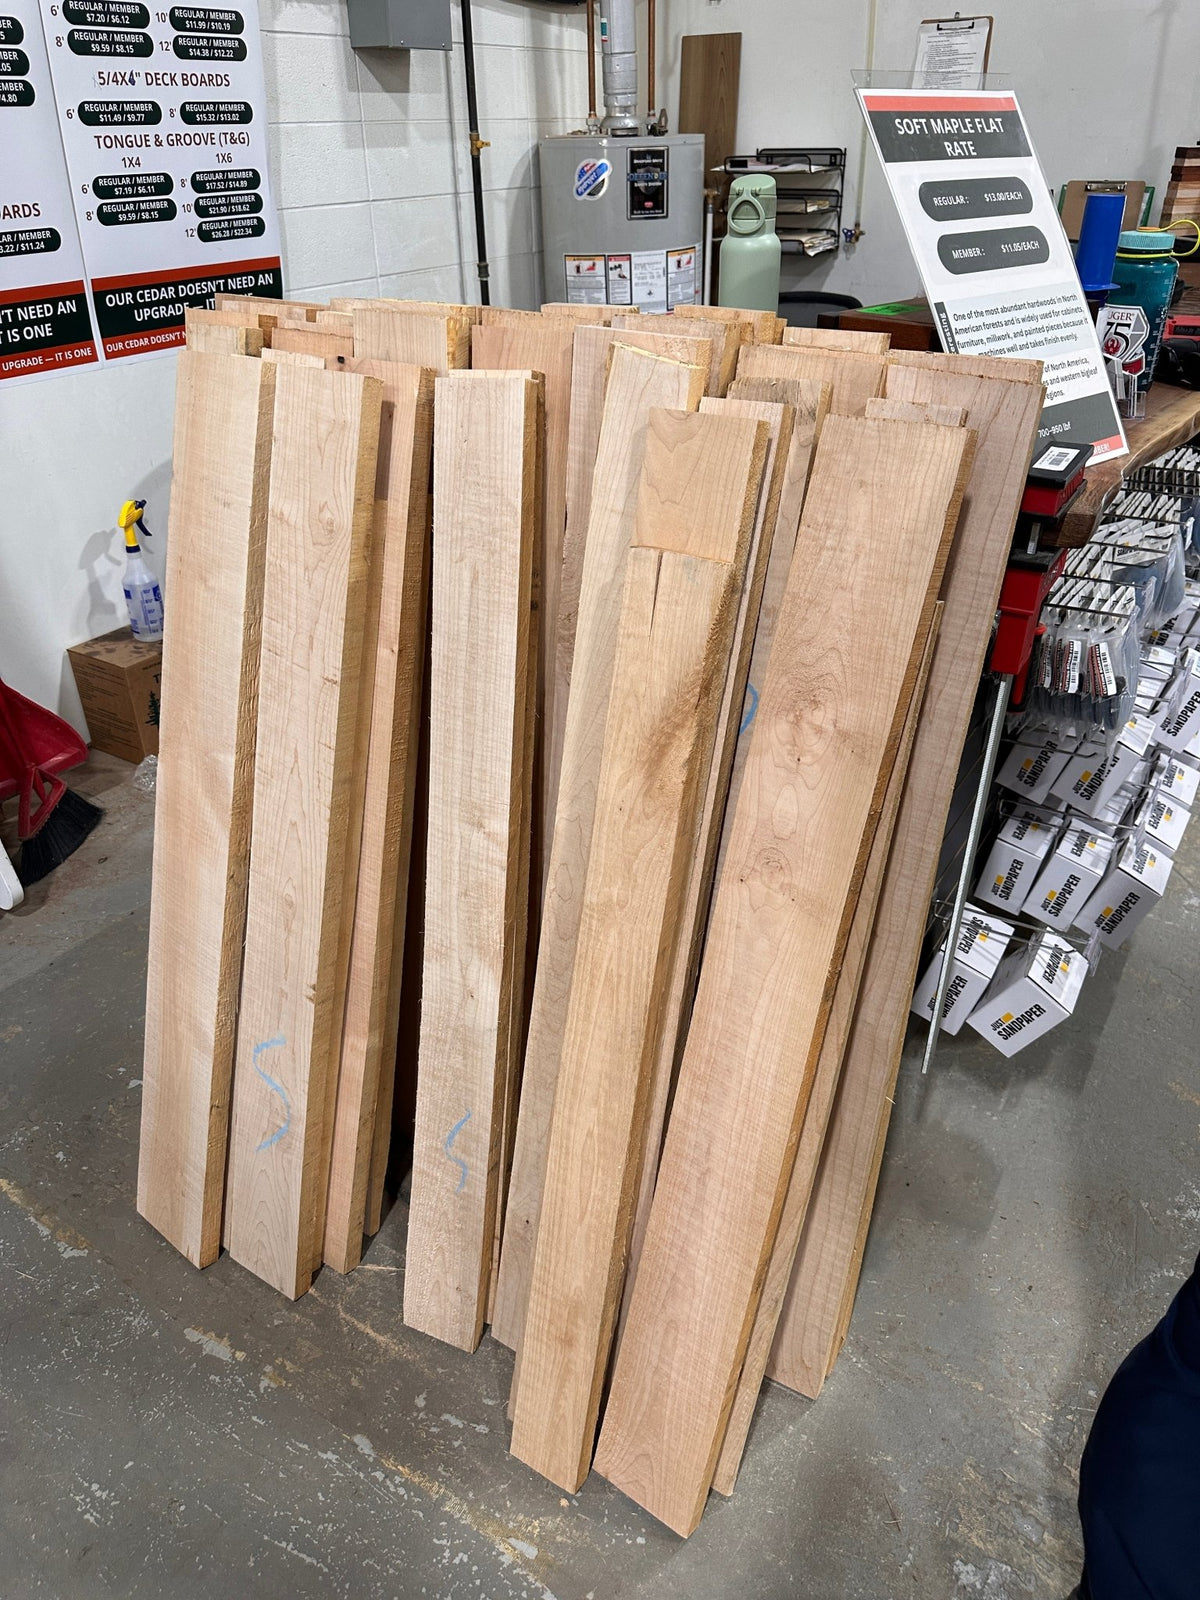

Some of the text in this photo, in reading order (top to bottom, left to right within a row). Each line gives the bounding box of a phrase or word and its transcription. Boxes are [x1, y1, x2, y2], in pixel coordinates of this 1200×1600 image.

[51, 5, 59, 16] 6'
[69, 1, 140, 14] REGULAR MEMBER
[87, 13, 130, 24] $7.20 $6.12
[155, 12, 168, 23] 10'
[175, 9, 236, 21] REGULAR MEMBER
[55, 36, 64, 47] 8'
[74, 31, 144, 43] REGULAR MEMBER
[179, 38, 239, 48] REGULAR MEMBER
[91, 44, 110, 52] $9.59
[159, 41, 171, 51] 12'
[145, 72, 178, 86] DECK
[181, 73, 230, 87] BOARDS
[66, 109, 75, 119] 6'
[128, 114, 144, 122] $9.77
[169, 108, 176, 118] 8'
[895, 118, 1004, 135] SOFT MAPLE FLAT
[94, 132, 250, 149] TONGUE & GROOVE (T&G)
[944, 141, 977, 156] RATE
[122, 156, 141, 168] 1X4
[216, 153, 232, 164] 1X6
[98, 175, 165, 186] REGULAR MEMBER
[196, 171, 253, 181] REGULAR MEMBER
[81, 184, 89, 194] 6'
[180, 178, 187, 188] 8'
[115, 187, 132, 195] $7.19
[984, 191, 1023, 202] $13.00/EACH
[103, 201, 168, 212] REGULAR MEMBER
[199, 195, 256, 206] REGULAR MEMBER
[0, 203, 40, 220] ARDS
[182, 204, 193, 213] 10'
[86, 211, 93, 221] 8'
[202, 219, 258, 230] REGULAR MEMBER
[18, 231, 52, 241] MEMBER
[185, 228, 196, 237] 12'
[20, 241, 44, 251] $11.24
[106, 273, 273, 307] OUR CEDAR DOESN'T NEED AN
[17, 304, 53, 321] NEED
[57, 300, 76, 315] AN
[953, 313, 966, 321] One
[967, 310, 973, 319] of
[974, 310, 984, 318] the
[985, 307, 1000, 316] most
[1000, 303, 1027, 313] abundant
[1027, 299, 1056, 308] hardwoods
[1062, 294, 1077, 302] North
[954, 324, 983, 335] American
[983, 321, 1004, 330] forests
[1004, 317, 1015, 326] and
[1015, 316, 1021, 324] is
[1021, 314, 1039, 323] widely
[1039, 310, 1052, 320] used
[1052, 309, 1060, 317] for
[7, 329, 20, 342] IS
[23, 323, 53, 340] ONE
[940, 312, 955, 354] eresting
[957, 339, 986, 349] furniture,
[986, 331, 1013, 343] millwork,
[1013, 328, 1024, 338] and
[1024, 325, 1045, 337] painted
[1046, 323, 1063, 333] pieces
[1062, 319, 1084, 328] because
[106, 343, 124, 352] OUR
[125, 337, 149, 349] CEDAR
[150, 332, 180, 345] DOESN'T
[1006, 344, 1018, 353] well
[1019, 341, 1029, 351] and
[1029, 340, 1045, 348] takes
[1045, 336, 1060, 345] finish
[2, 347, 92, 371] UPGRADE IT IS ONE
[1044, 364, 1050, 373] of
[1050, 362, 1066, 371] North
[1050, 376, 1060, 385] and
[1061, 372, 1080, 382] western
[1023, 740, 1058, 787] SANDPAPER
[998, 859, 1024, 901] SANDPAPER
[1048, 873, 1082, 917] SANDPAPER
[1101, 892, 1141, 935] SANDPAPER
[1094, 914, 1106, 928] JUST
[990, 1018, 1006, 1031] JUST
[997, 1004, 1046, 1040] SANDPAPER
